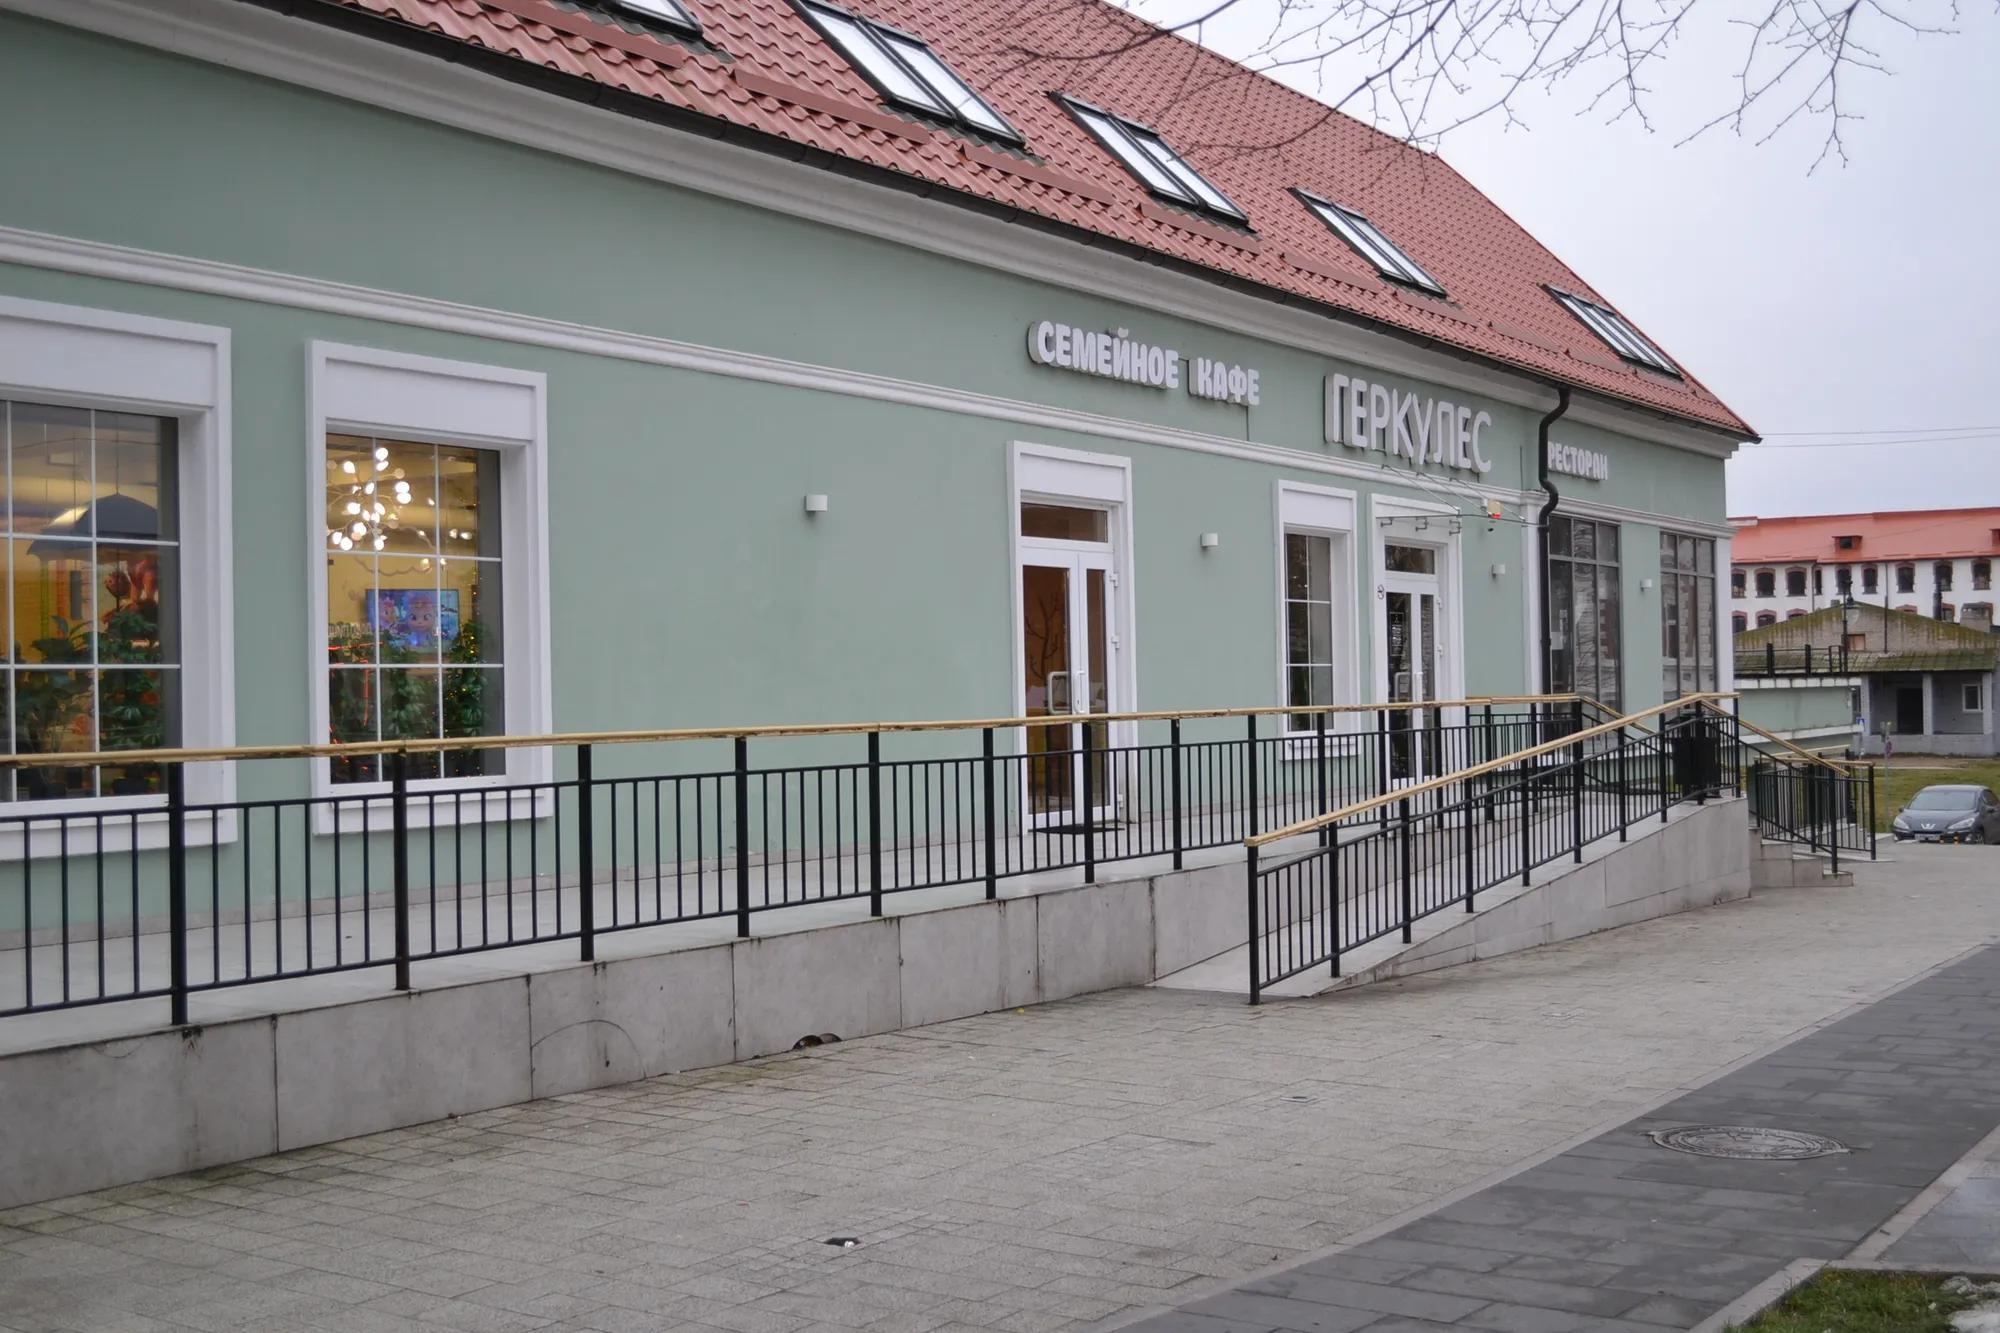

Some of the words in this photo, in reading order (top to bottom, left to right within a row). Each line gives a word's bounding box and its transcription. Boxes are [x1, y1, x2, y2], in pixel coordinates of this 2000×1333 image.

[1036, 320, 1179, 389] СЕМЕЙНОЕ
[1195, 357, 1260, 406] КАФЕ
[1331, 373, 1492, 473] ГЕРКУЛЕС
[1547, 441, 1608, 481] РЕСТОРАН
